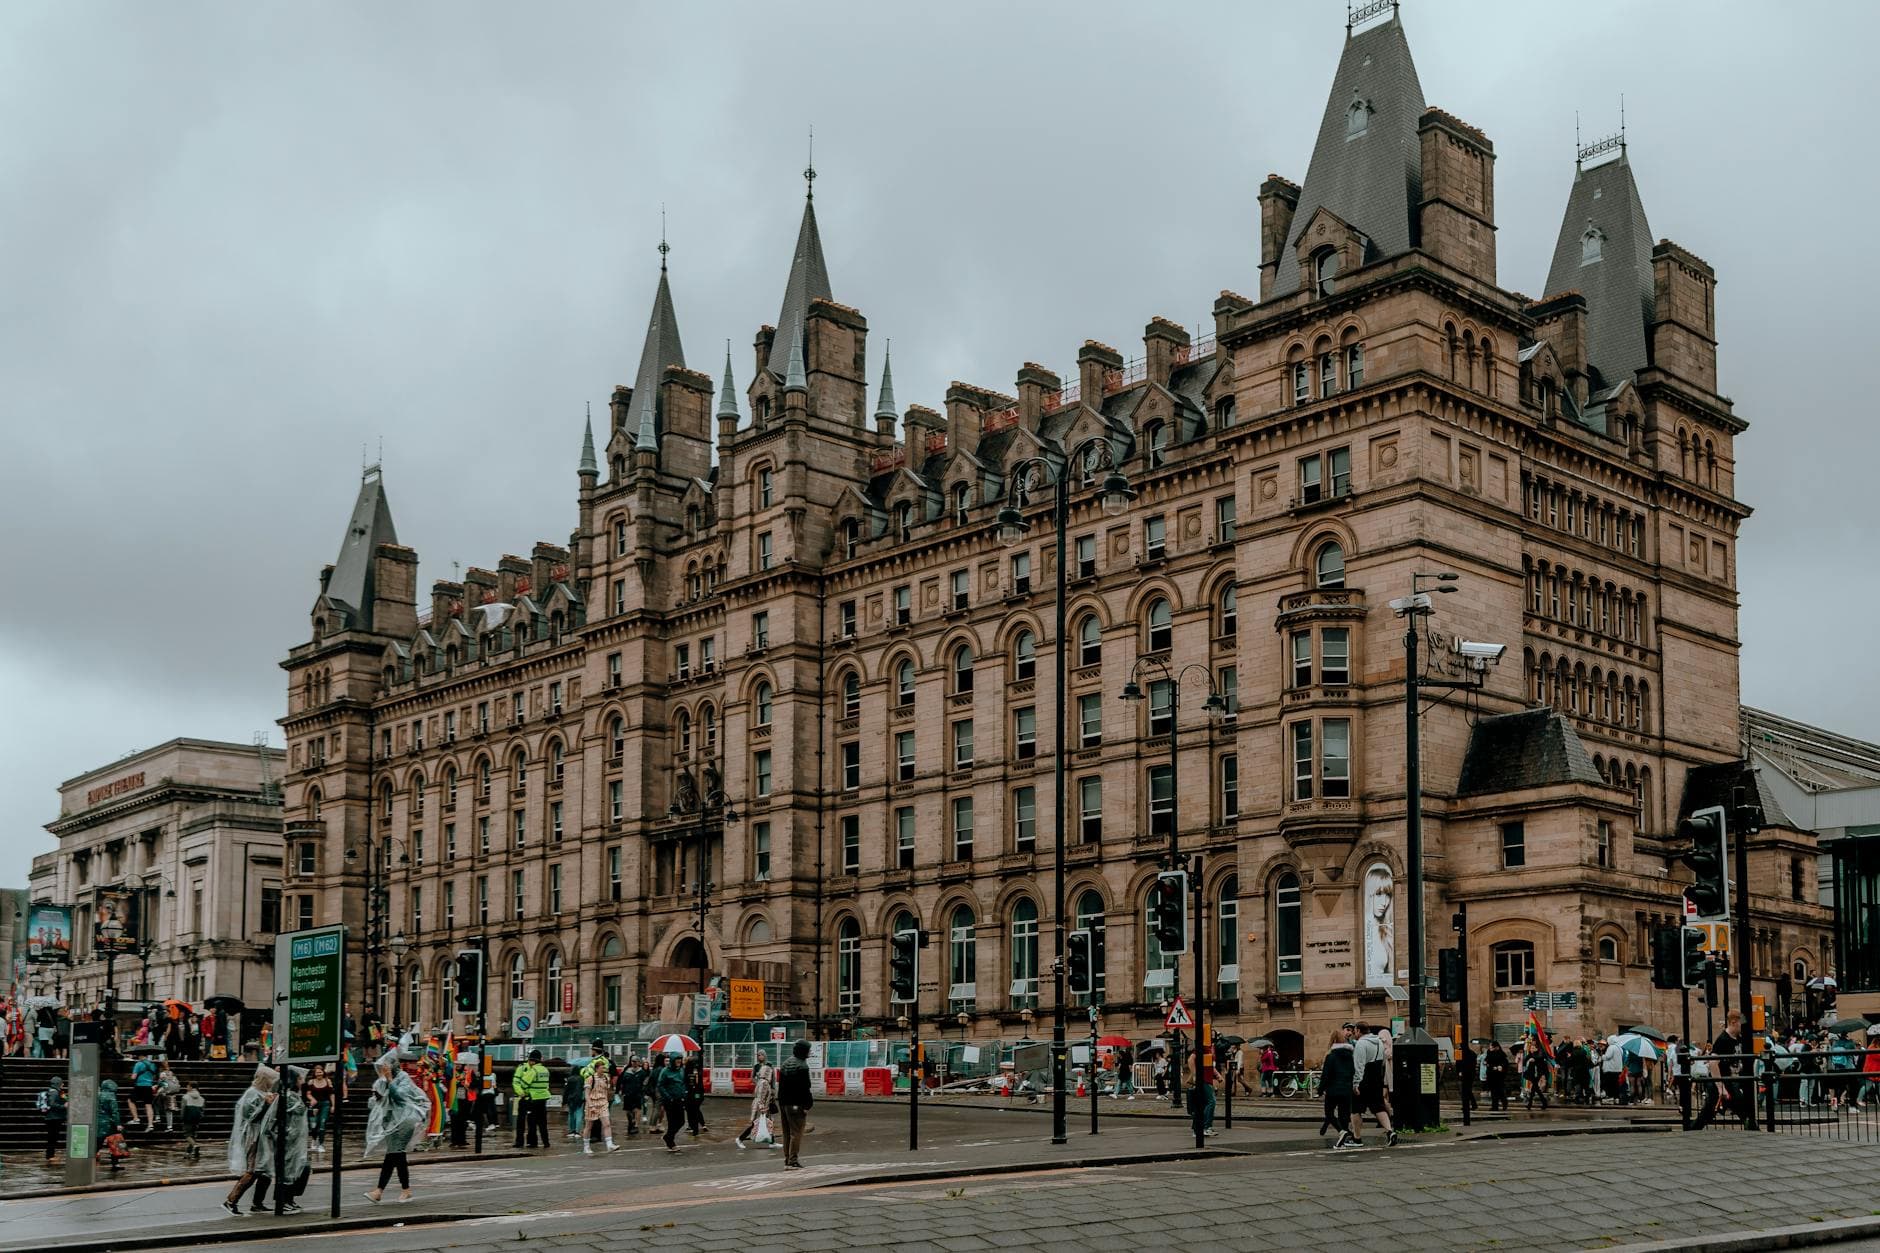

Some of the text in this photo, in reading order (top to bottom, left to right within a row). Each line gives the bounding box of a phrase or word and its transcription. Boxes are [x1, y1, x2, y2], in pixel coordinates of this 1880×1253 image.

[294, 938, 337, 955] (M6) (M62)
[292, 965, 327, 977] Manchester
[292, 980, 326, 992] Warrington
[733, 984, 760, 993] CLIMAX
[291, 998, 318, 1009] Wallasey
[290, 1010, 326, 1023] Birkenhead
